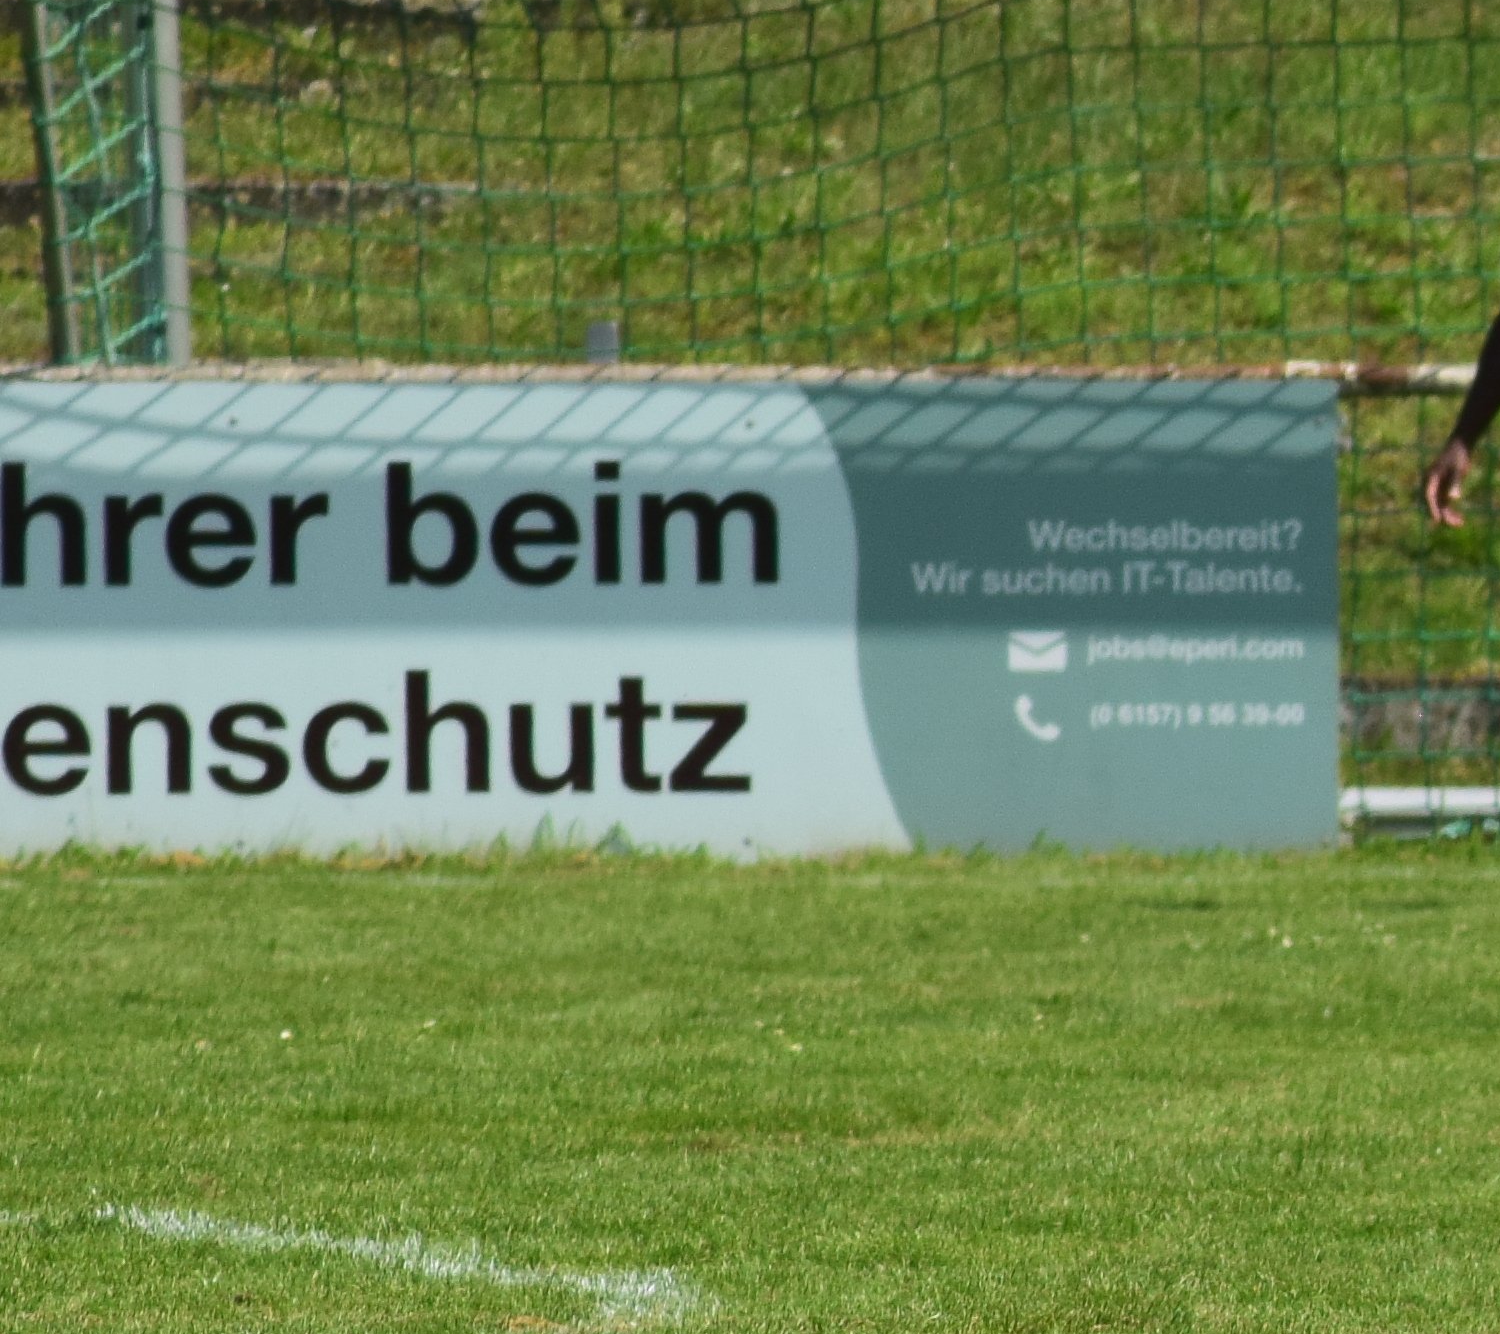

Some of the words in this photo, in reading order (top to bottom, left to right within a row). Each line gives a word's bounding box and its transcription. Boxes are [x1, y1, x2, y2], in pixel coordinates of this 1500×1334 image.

[0, 461, 331, 589] hrer
[386, 460, 780, 588] beim
[1028, 518, 1303, 553] Wechselbereit?
[911, 561, 971, 595] Wir
[982, 562, 1112, 595] suchen
[1123, 561, 1304, 595] IT-Talente.
[2, 670, 753, 797] enschutz
